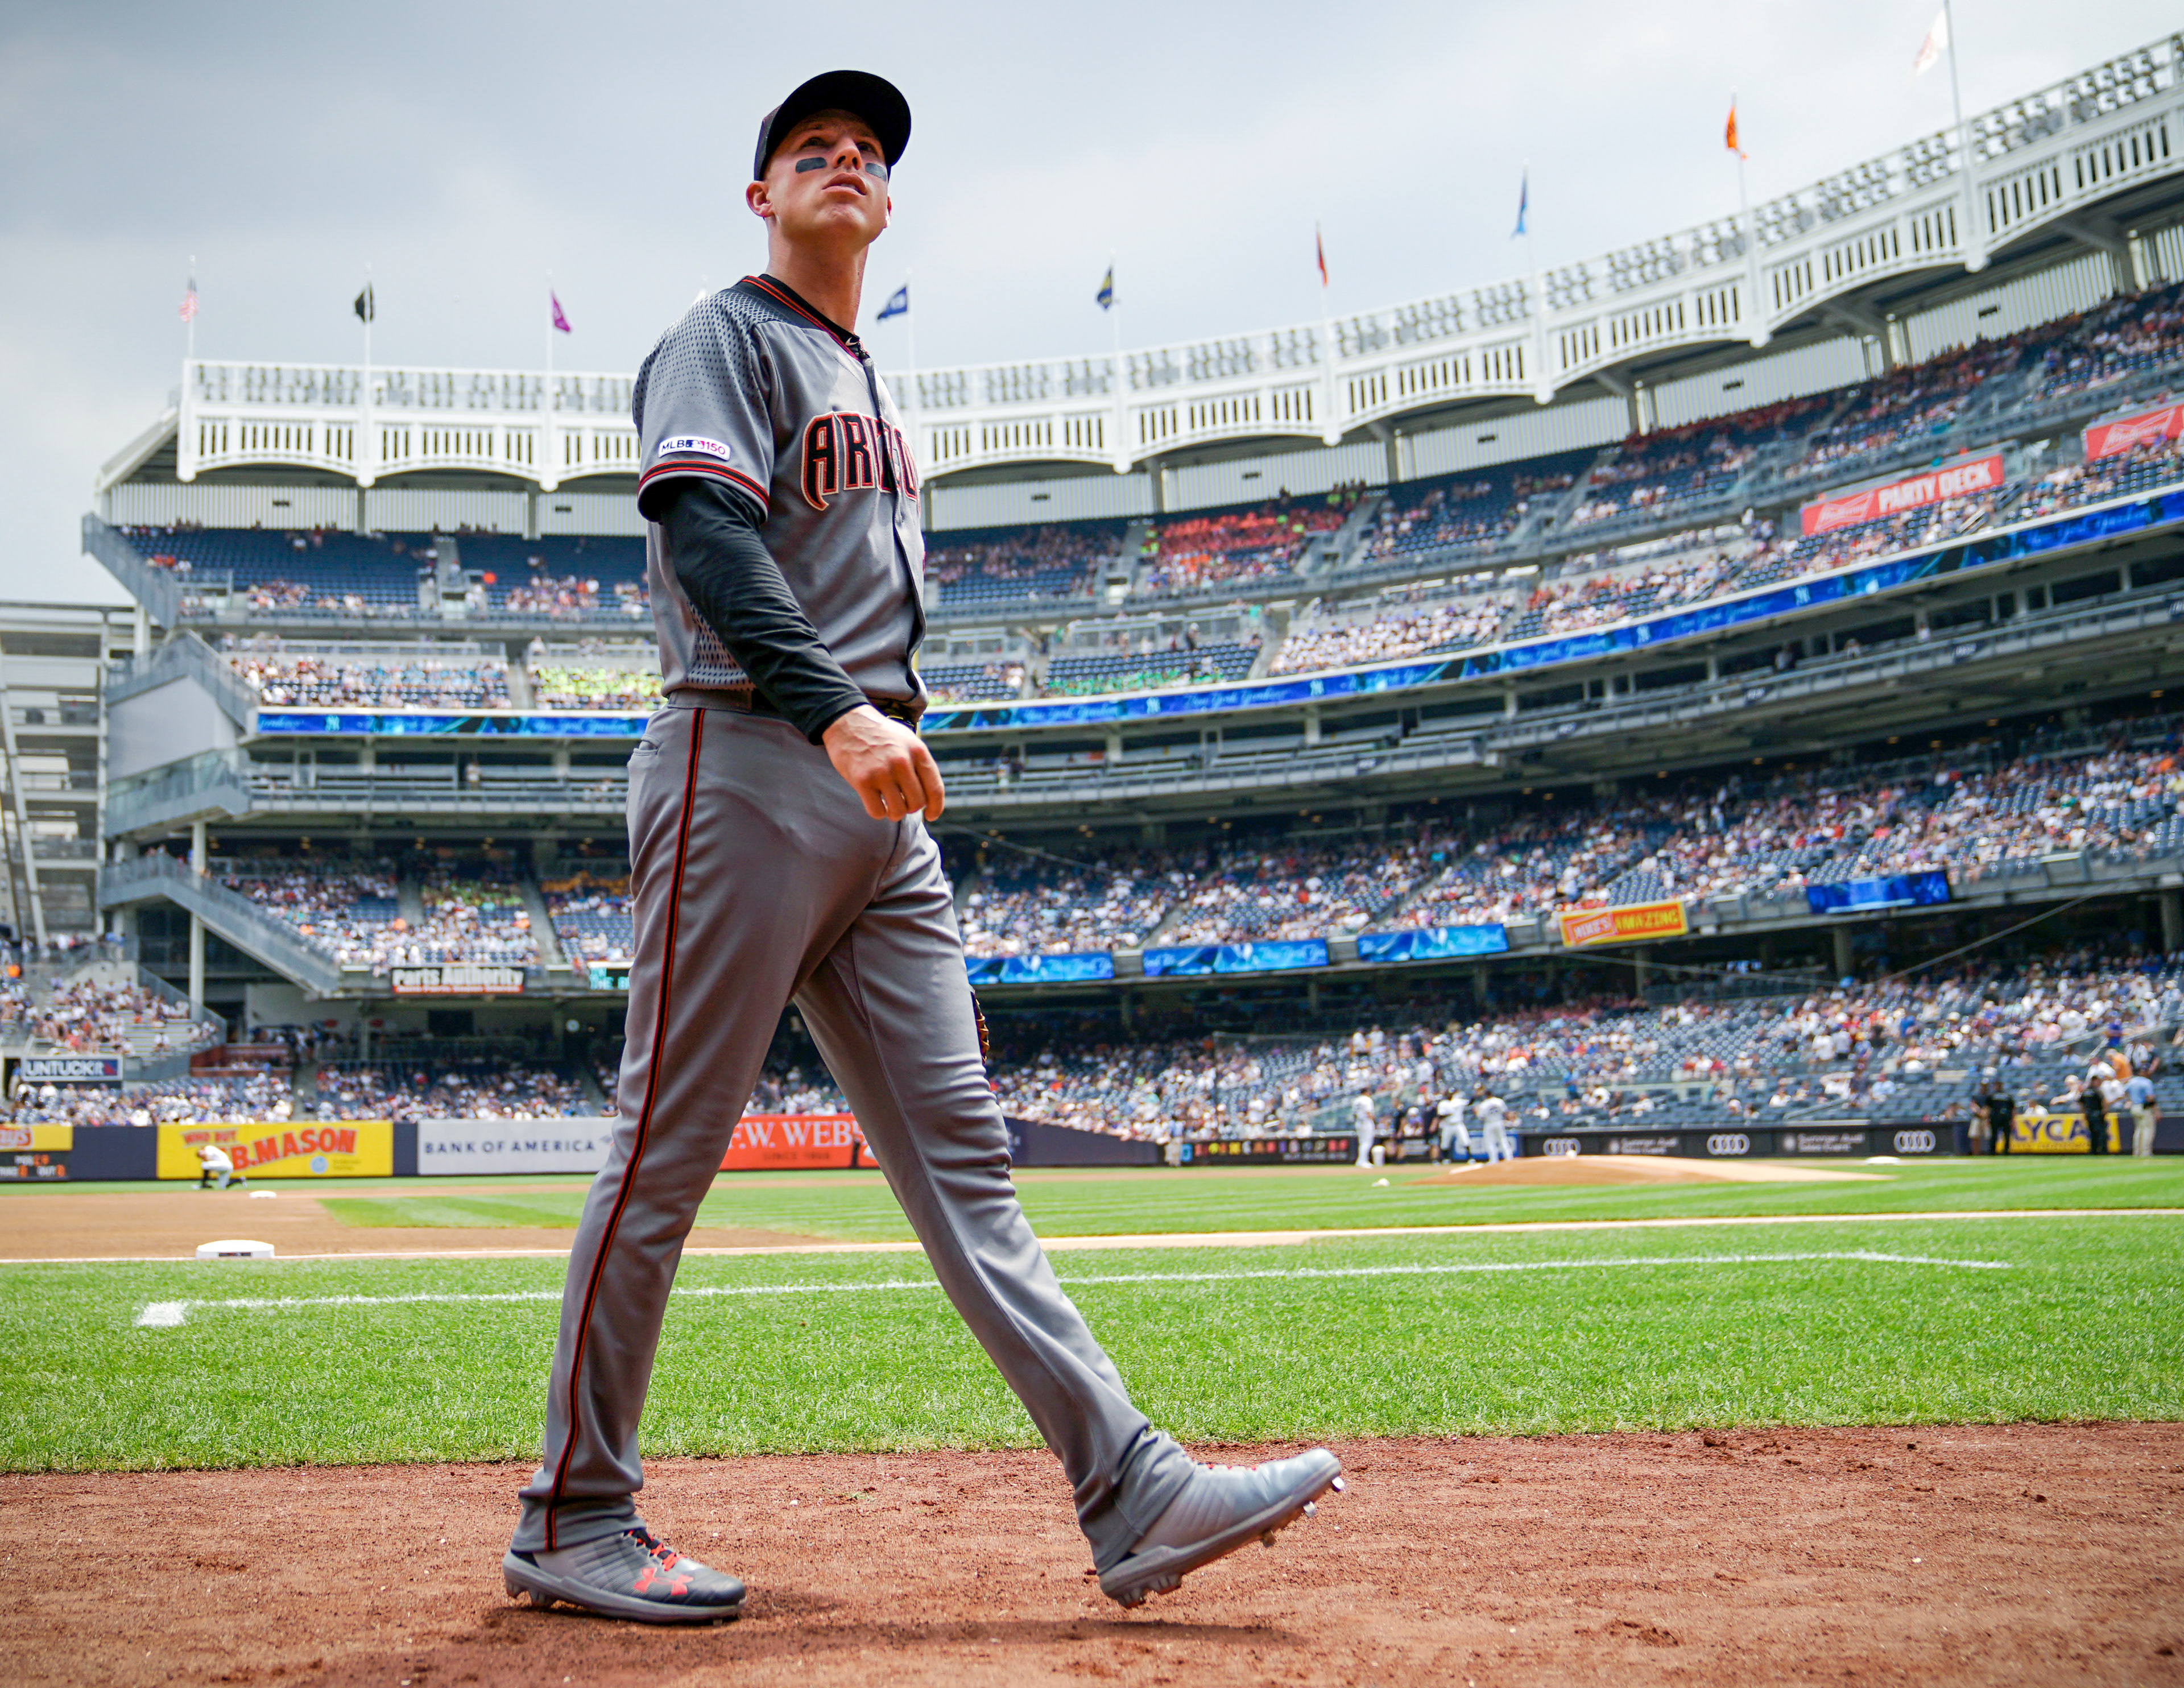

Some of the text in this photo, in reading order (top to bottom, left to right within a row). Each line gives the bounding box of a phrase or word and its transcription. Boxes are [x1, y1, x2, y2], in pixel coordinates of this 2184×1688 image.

[661, 440, 726, 455] MLB 150
[800, 411, 920, 516] ARIZO
[1879, 476, 1935, 512] PARTY
[1938, 461, 1991, 498] DECK
[392, 965, 524, 986] Parts Authority
[424, 1139, 595, 1154] BANK OF AMERICA
